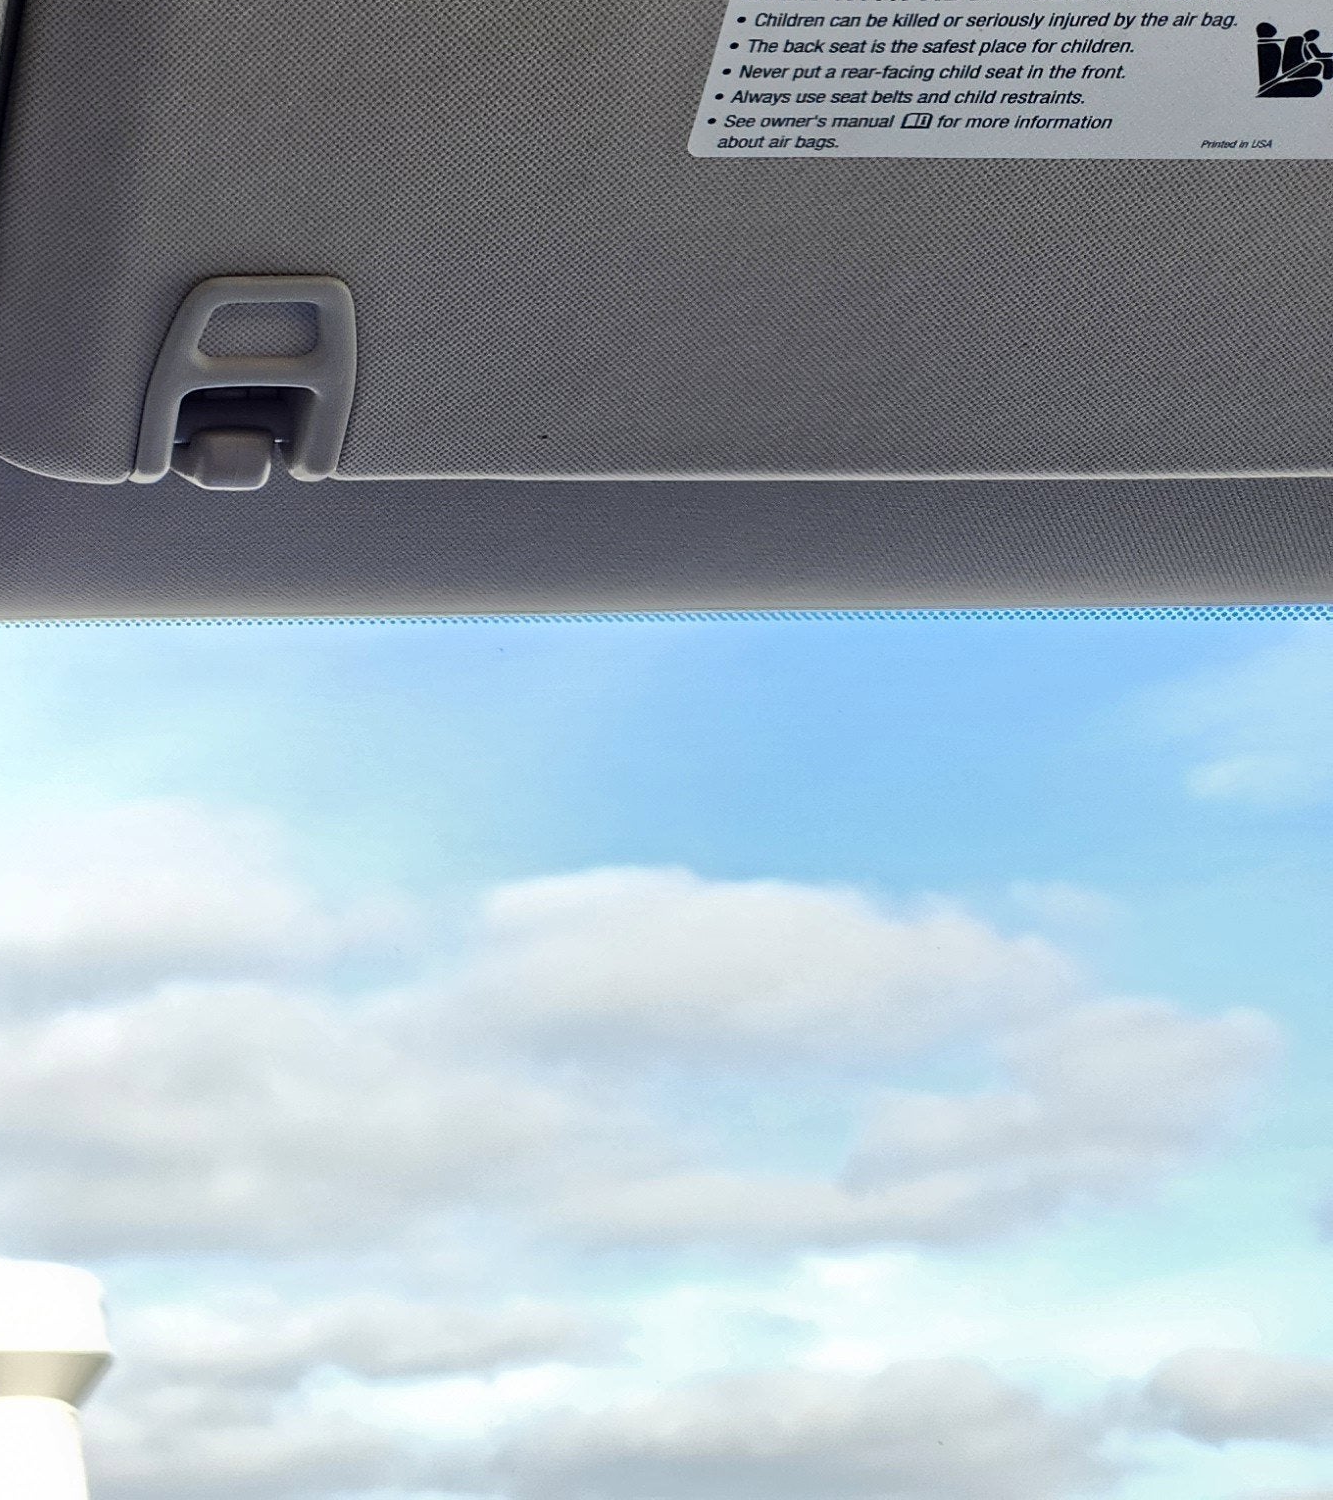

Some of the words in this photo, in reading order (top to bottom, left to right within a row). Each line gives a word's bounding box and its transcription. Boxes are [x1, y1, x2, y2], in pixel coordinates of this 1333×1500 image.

[754, 12, 825, 28] Children
[829, 16, 860, 28] can
[866, 12, 888, 28] be
[892, 12, 940, 28] killed
[943, 16, 963, 28] or
[965, 12, 1044, 30] seriously
[1048, 12, 1110, 30] injured
[1113, 12, 1136, 30] by
[1140, 12, 1168, 27] the
[1172, 12, 1198, 27] air
[1201, 12, 1238, 29] bag.
[747, 39, 779, 53] The
[783, 39, 825, 53] back
[829, 41, 867, 53] seat
[870, 39, 885, 53] is
[890, 39, 918, 53] the
[921, 39, 975, 53] safest
[978, 39, 1026, 55] place
[1032, 38, 1056, 53] for
[1060, 39, 1135, 53] children.
[738, 65, 788, 79] Never
[792, 66, 820, 81] put
[824, 69, 835, 79] a
[840, 65, 934, 81] rear-facing
[938, 65, 981, 79] child
[985, 66, 1024, 79] seat
[1027, 65, 1043, 79] in
[1048, 65, 1077, 79] the
[1081, 65, 1126, 79] front.
[730, 90, 791, 106] Always
[796, 93, 823, 104] use
[830, 91, 868, 104] seat
[873, 90, 913, 104] belts
[916, 90, 950, 104] and
[953, 90, 997, 104] child
[1000, 90, 1085, 105] restraints.
[723, 114, 756, 128] See
[760, 114, 828, 128] owner's
[831, 114, 895, 128] manual
[936, 114, 961, 129] for
[964, 117, 1010, 129] more
[1013, 115, 1113, 130] information
[717, 135, 765, 149] about
[768, 135, 789, 149] air
[794, 135, 839, 152] bags.
[1201, 139, 1237, 149] Printed
[1239, 139, 1248, 149] in
[1251, 139, 1273, 149] USA
